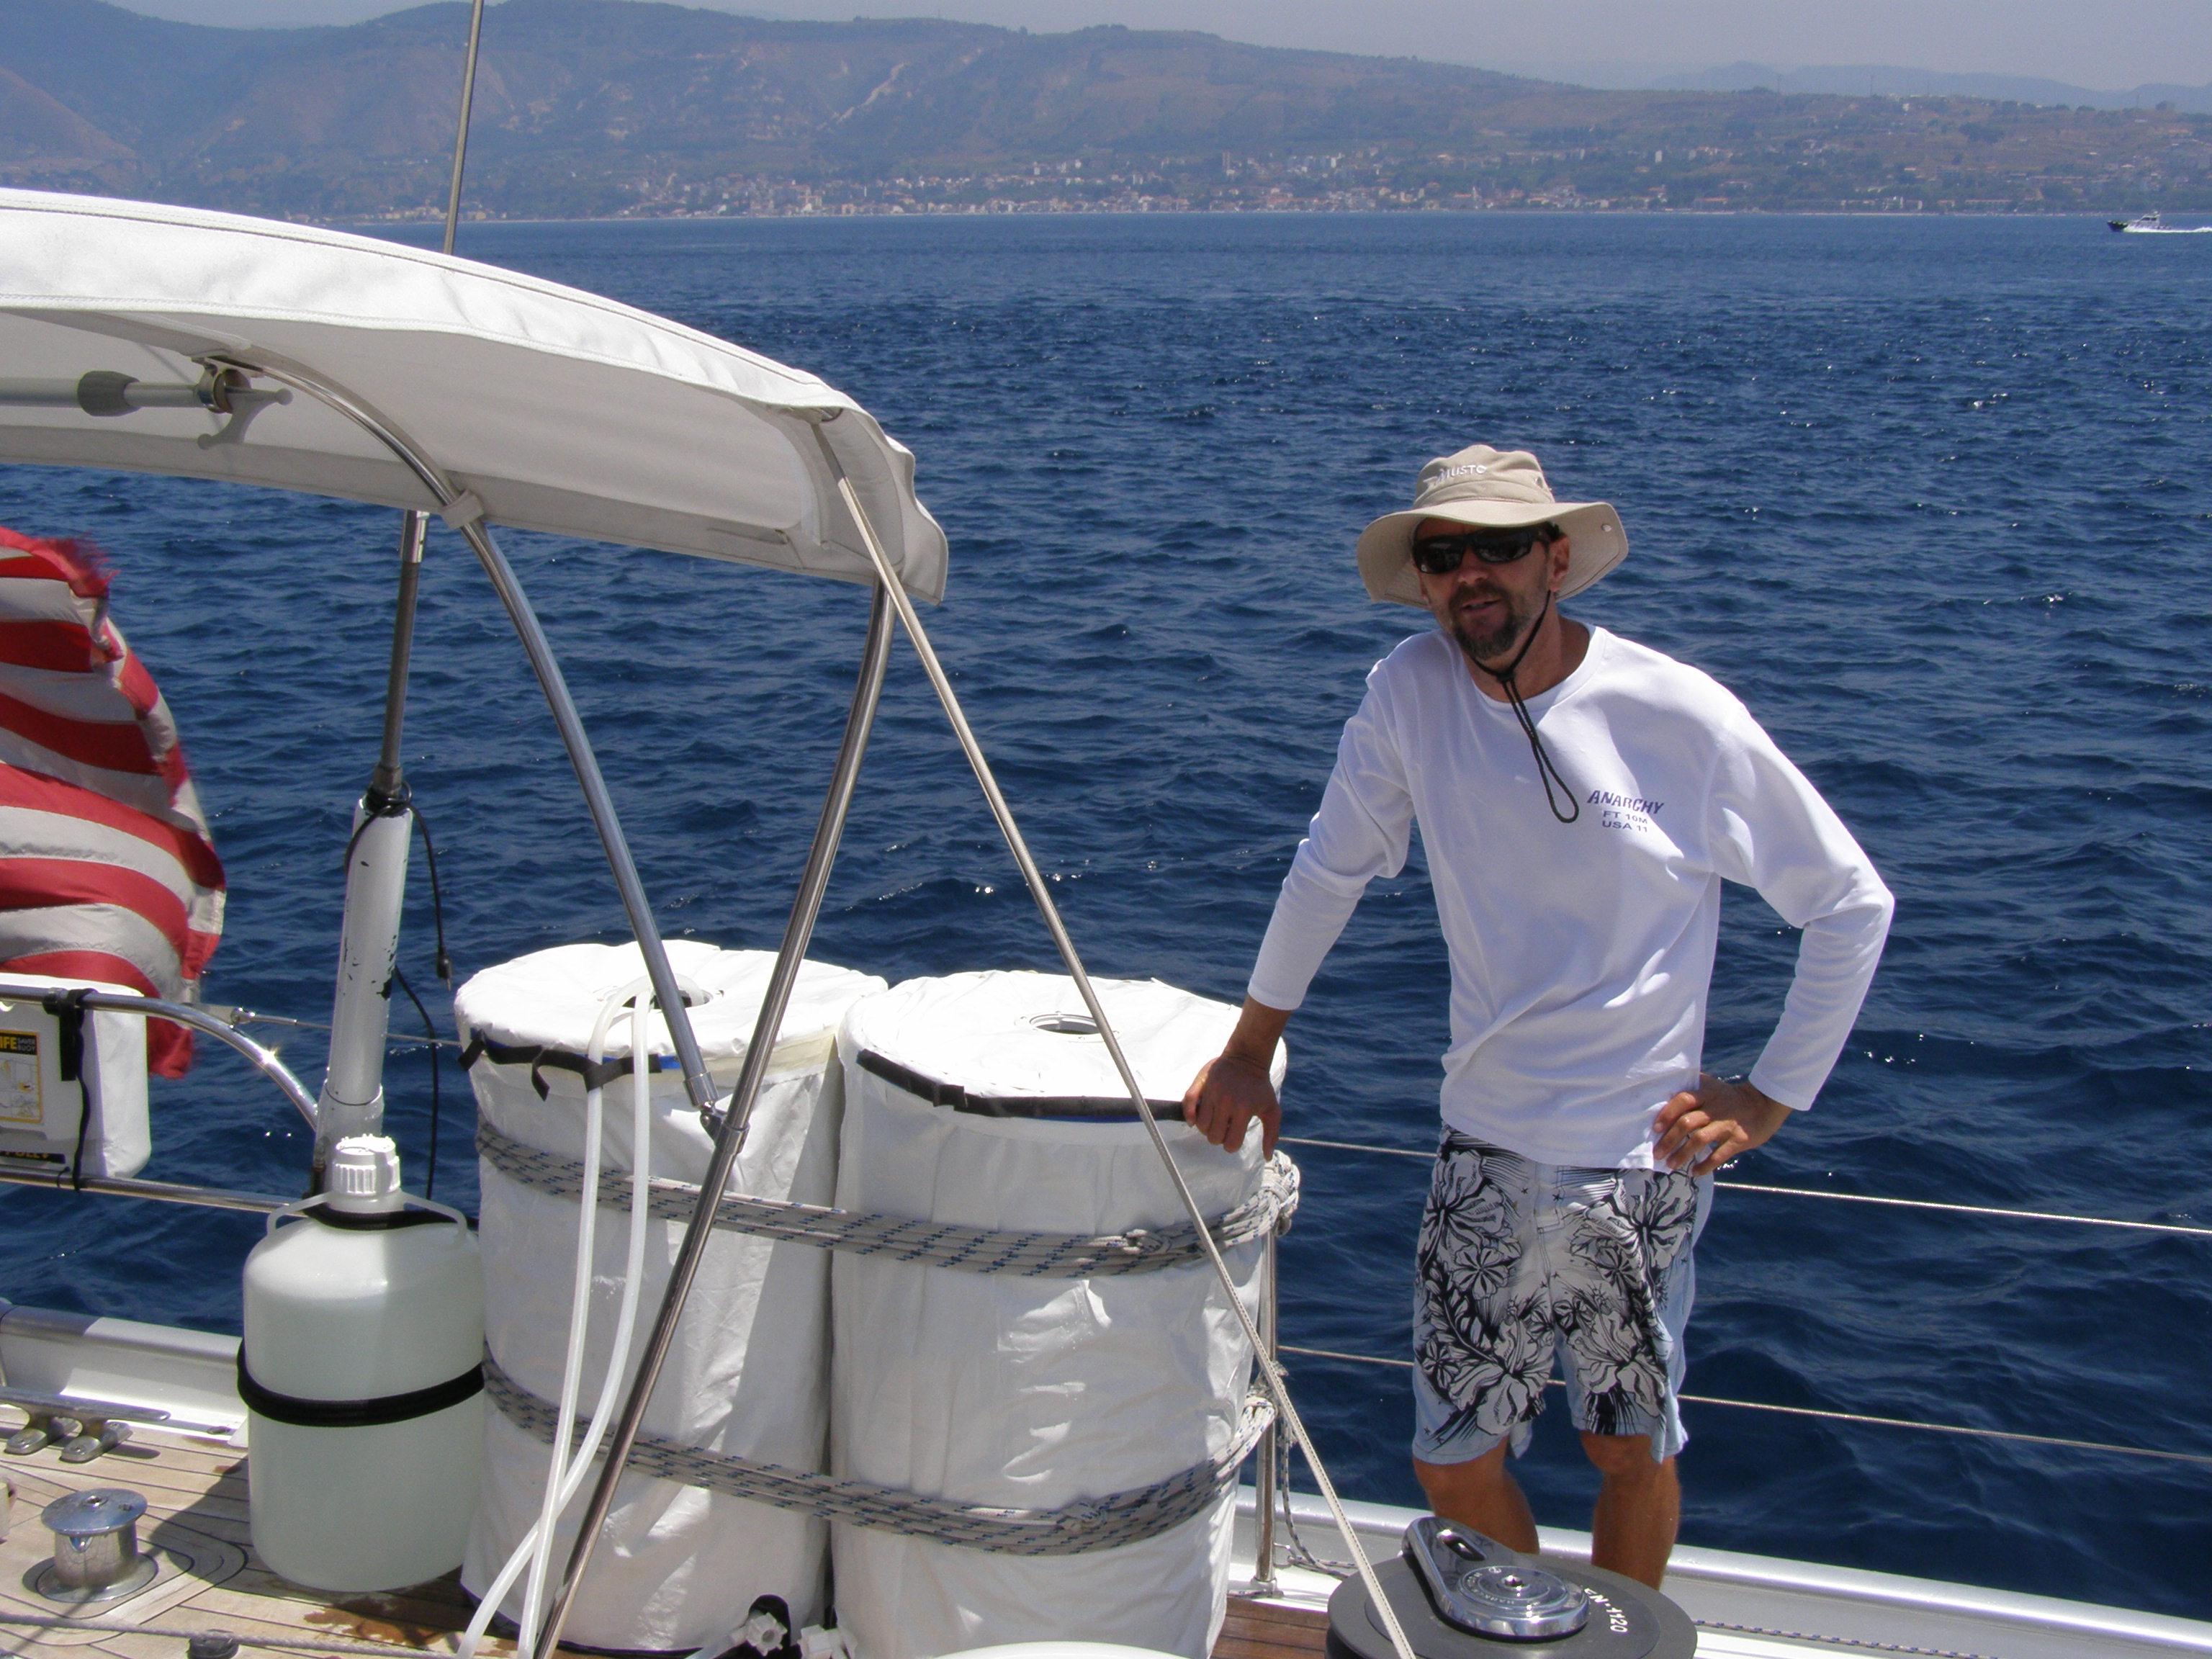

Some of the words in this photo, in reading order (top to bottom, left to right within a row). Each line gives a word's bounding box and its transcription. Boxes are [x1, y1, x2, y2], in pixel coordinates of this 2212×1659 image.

[1437, 464, 1488, 482] MUSTO
[1587, 790, 1664, 814] ANARCHY
[1602, 820, 1632, 830] USA
[1626, 814, 1647, 824] 10M
